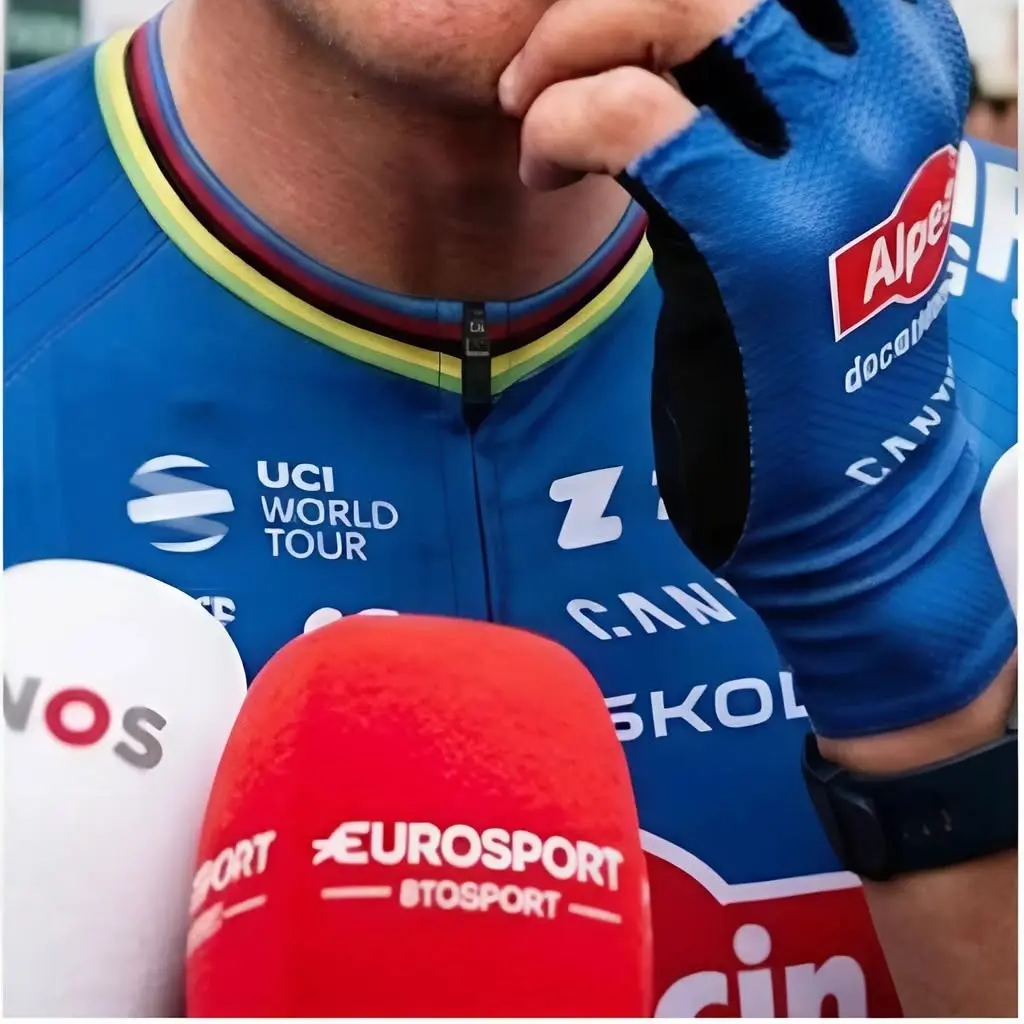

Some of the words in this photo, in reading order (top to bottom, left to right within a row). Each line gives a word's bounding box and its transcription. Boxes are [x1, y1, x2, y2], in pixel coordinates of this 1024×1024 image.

[257, 460, 334, 492] UCI
[261, 495, 398, 530] WORLD
[264, 528, 367, 561] TOUR
[566, 578, 738, 641] CAN
